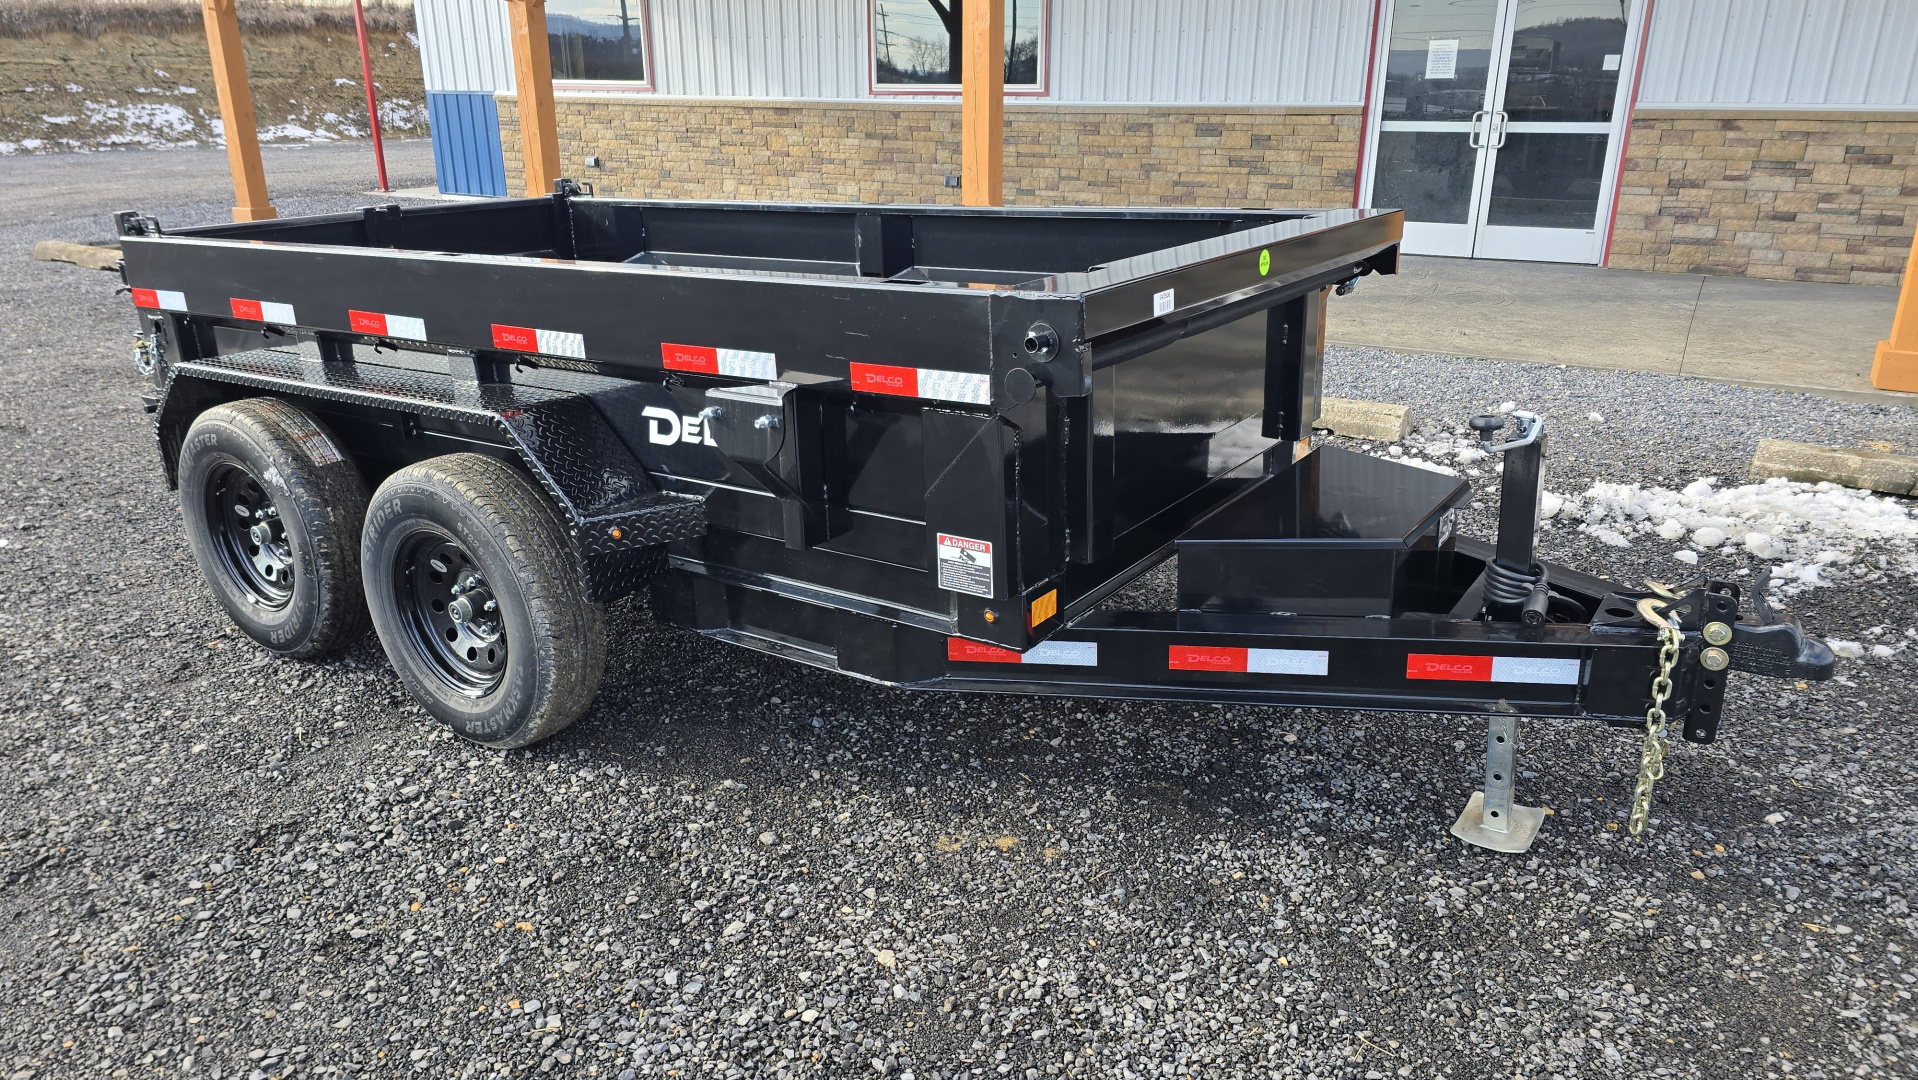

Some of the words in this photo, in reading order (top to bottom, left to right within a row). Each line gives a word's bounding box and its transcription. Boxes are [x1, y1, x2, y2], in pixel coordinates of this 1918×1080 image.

[358, 318, 380, 327] DELCO
[502, 333, 528, 343] DELCO
[675, 353, 707, 364] DELCO
[865, 373, 903, 385] DELCO
[364, 498, 403, 566] STRIDER
[952, 538, 986, 553] DANGER
[270, 597, 305, 645] STRIDER
[965, 646, 1006, 655] DELCO
[1187, 654, 1232, 663] DELCO
[1425, 663, 1472, 672] DELCO
[405, 669, 434, 705] SPECIAL
[465, 664, 524, 735] TASKMASTER
